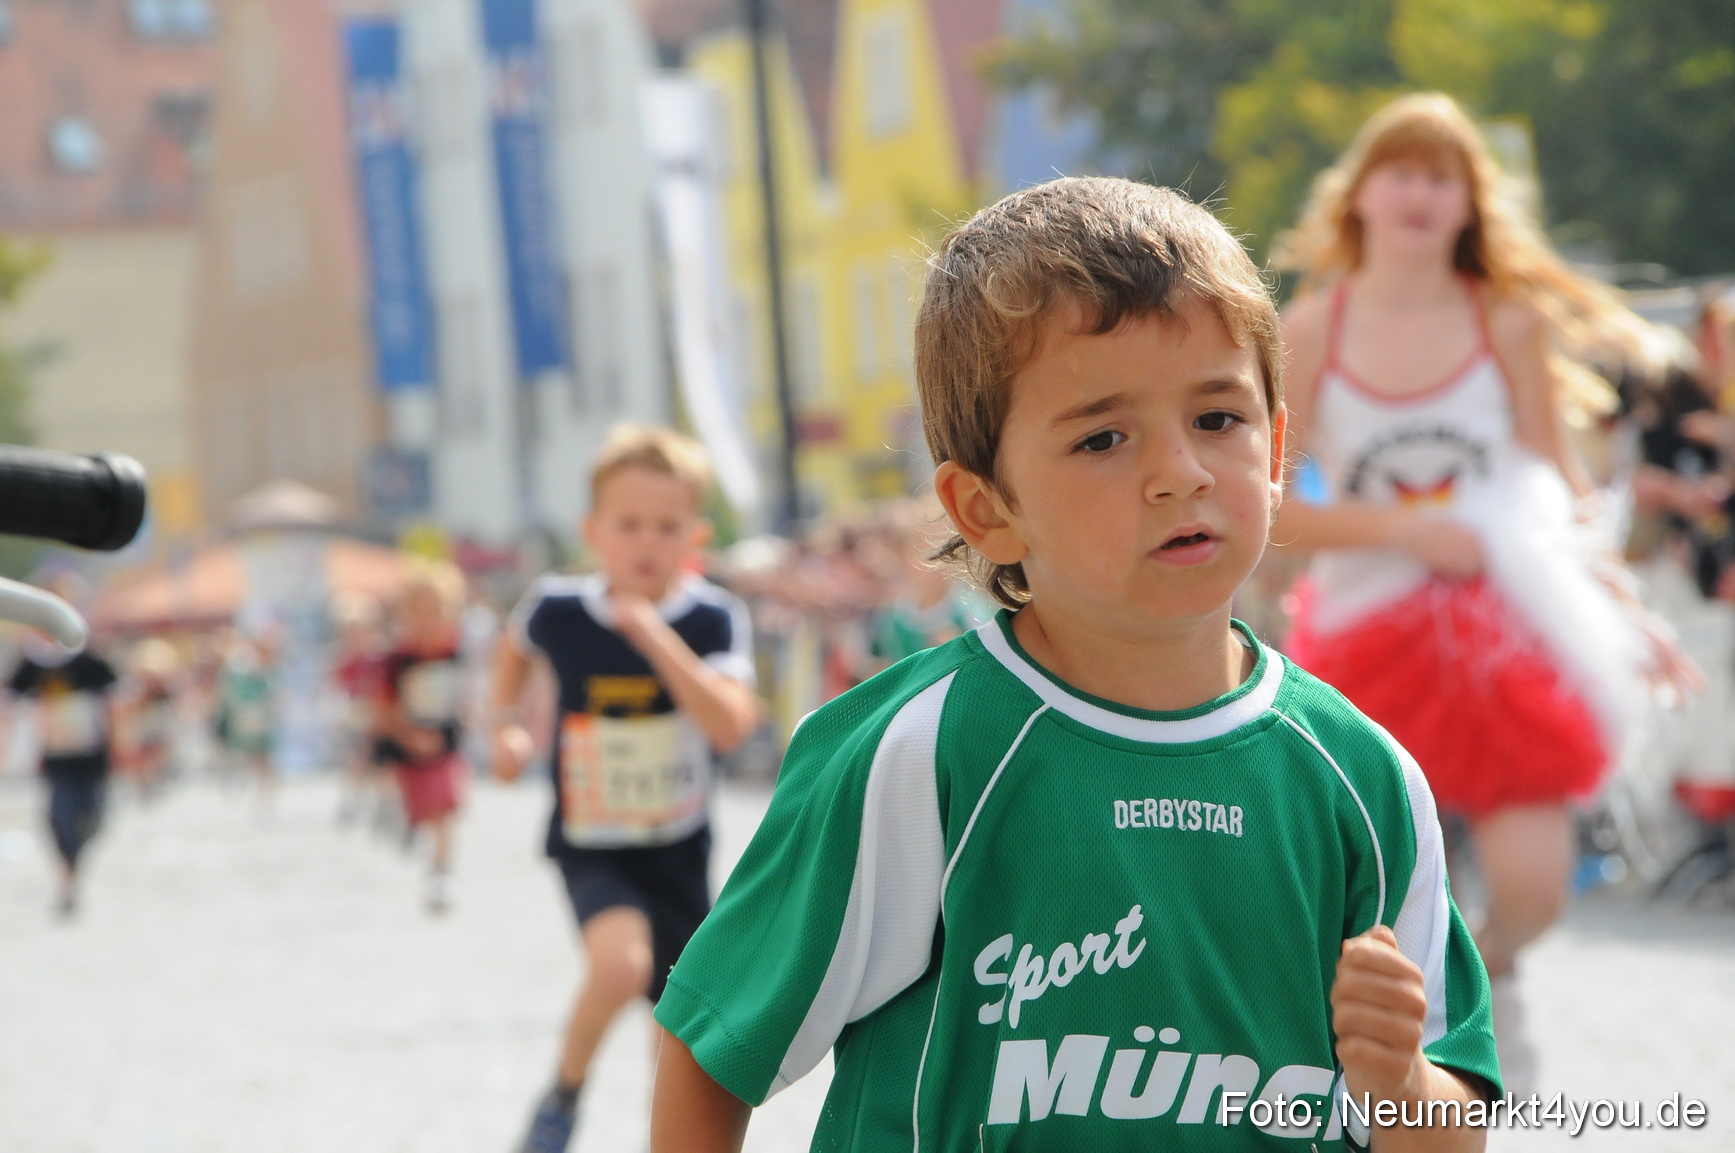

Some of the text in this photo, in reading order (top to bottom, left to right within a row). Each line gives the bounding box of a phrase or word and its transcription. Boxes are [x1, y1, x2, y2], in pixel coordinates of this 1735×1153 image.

[1114, 799, 1243, 837] DERBYSTAR
[974, 904, 1147, 1029] Sport
[987, 1025, 1342, 1141] Münc
